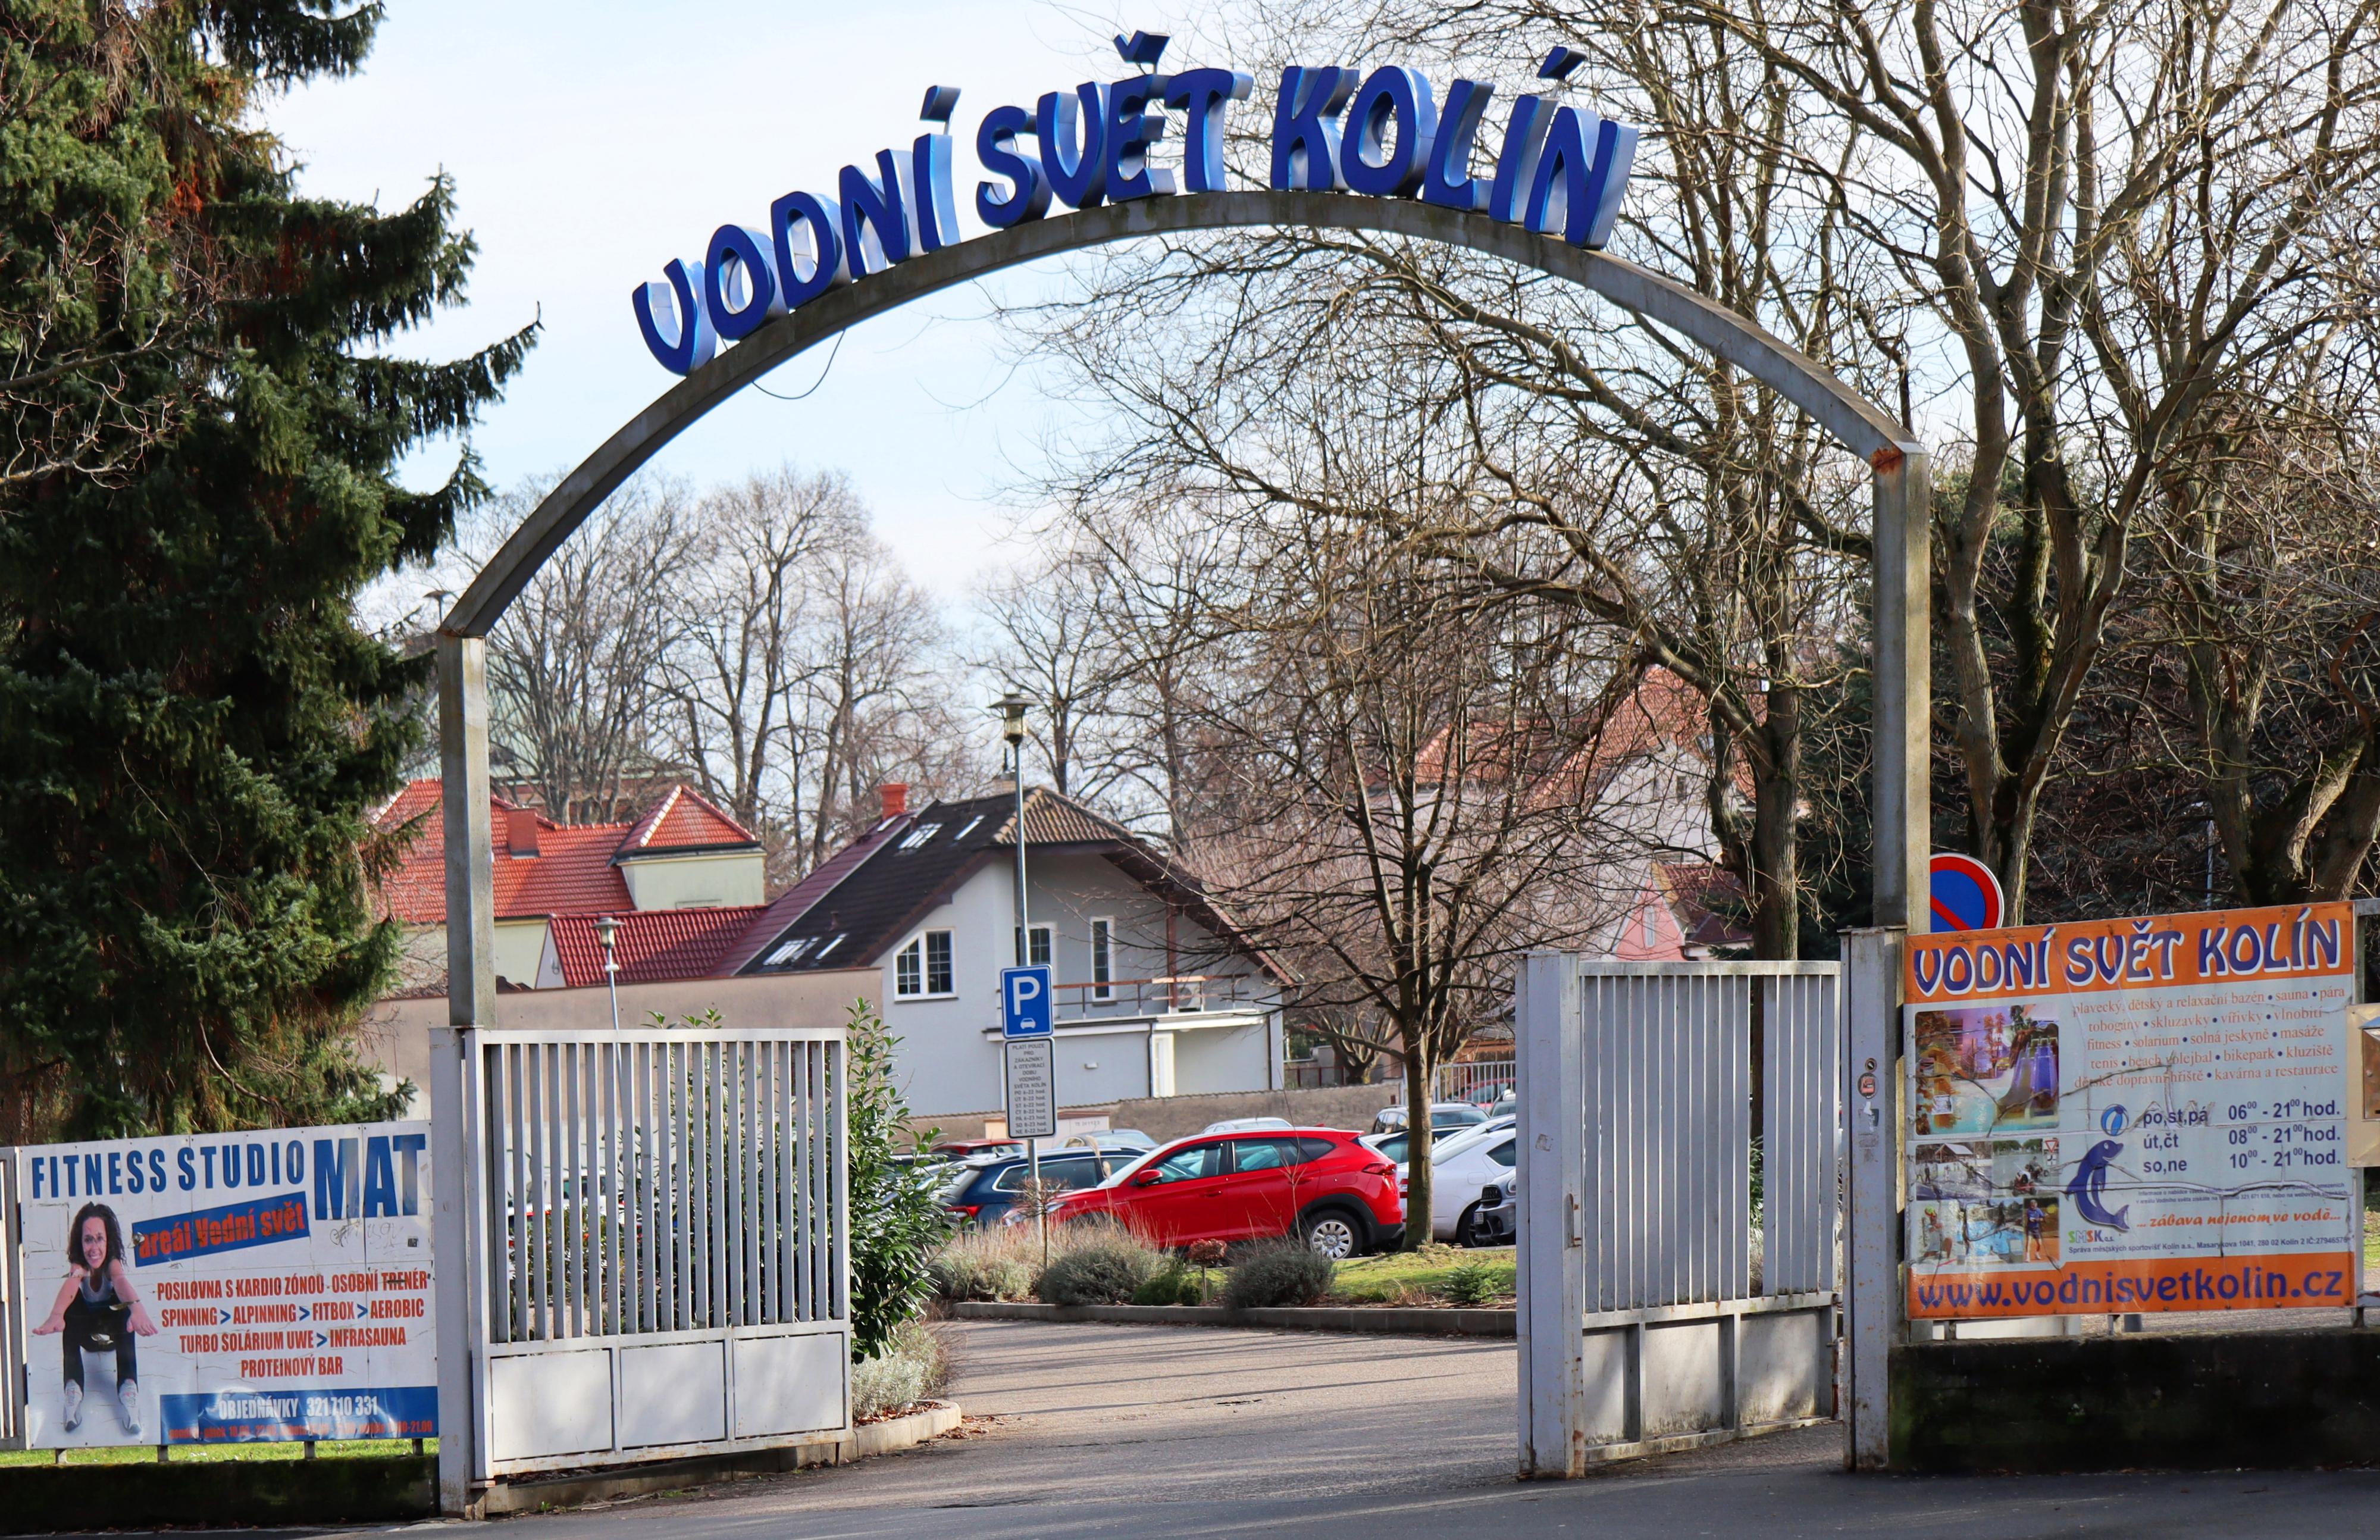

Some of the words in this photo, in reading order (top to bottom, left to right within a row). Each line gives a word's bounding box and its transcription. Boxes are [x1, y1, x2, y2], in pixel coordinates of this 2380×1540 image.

[632, 84, 962, 377] VODNÍ
[976, 30, 1254, 229] SVĚT
[1270, 46, 1639, 249] KOLÍN
[1913, 926, 2057, 997] VODNÍ
[2066, 919, 2185, 987] SVĚT
[2199, 907, 2341, 978] KOLÍN
[1012, 976, 1041, 1016] P
[2128, 997, 2163, 1012] dětský
[2167, 999, 2173, 1009] a
[2177, 991, 2228, 1007] relaxační
[2231, 991, 2265, 1004] bazén
[2275, 990, 2309, 1001] sauna
[2320, 985, 2345, 1001] pára
[2088, 1019, 2141, 1034] tobogány
[2150, 1013, 2210, 1028] skluzavky
[2221, 1010, 2262, 1025] vířivky
[2274, 1006, 2323, 1021] vlnobití
[2087, 1038, 2121, 1051] fitness
[2132, 1034, 2179, 1048] solarium
[2190, 1030, 2221, 1045] solná
[2224, 1028, 2269, 1046] jeskyně
[2280, 1024, 2324, 1039] masáže
[2090, 1056, 2118, 1069] tenis
[2129, 1054, 2162, 1068] beach
[2166, 1050, 2212, 1067] volejbal
[2224, 1047, 2275, 1063] bikepark
[2286, 1044, 2333, 1058] kluziště
[2169, 1070, 2204, 1083] hřiště
[2215, 1067, 2261, 1081] kavárna
[2265, 1068, 2271, 1078] a
[2275, 1065, 2338, 1077] restaurace
[2303, 1100, 2340, 1117] hod.
[2143, 1133, 2179, 1151] út,čt
[2303, 1125, 2341, 1142] hod.
[2143, 1159, 2187, 1174] so,ne
[2304, 1149, 2341, 1166] hod.
[32, 1148, 167, 1199] FITNESS
[177, 1140, 305, 1191] STUDIO
[314, 1133, 426, 1220] MAT
[139, 1221, 192, 1259] areál
[195, 1208, 255, 1247] Vodní
[260, 1201, 305, 1237] svět
[2150, 1213, 2203, 1228] zábava
[2207, 1212, 2271, 1226] nejenom
[2273, 1213, 2289, 1222] ve
[2068, 1229, 2104, 1244] SMSK
[157, 1279, 223, 1301] POSILOVNA
[226, 1279, 233, 1298] S
[237, 1277, 282, 1297] KARDIO
[284, 1273, 324, 1295] ZÓNOU
[331, 1269, 378, 1293] OSOBNÍ
[381, 1267, 428, 1291] TRENÉR
[1918, 1267, 2344, 1309] www.vodnisvetkolin.cz
[161, 1307, 218, 1328] SPINNING
[233, 1304, 296, 1325] ALPINNING
[312, 1301, 355, 1321] FITBOX
[370, 1298, 424, 1319] AEROBIC
[180, 1334, 218, 1353] TURBO
[221, 1329, 284, 1353] SOLÁRIUM
[286, 1330, 314, 1350] UWE
[330, 1326, 407, 1348] INFRASAUNA
[241, 1354, 315, 1378] PROTEINOVÝ
[318, 1356, 343, 1376] BAR
[218, 1395, 299, 1420] OBJEDNÁVKY
[306, 1396, 329, 1417] 321
[355, 1395, 378, 1416] 331
